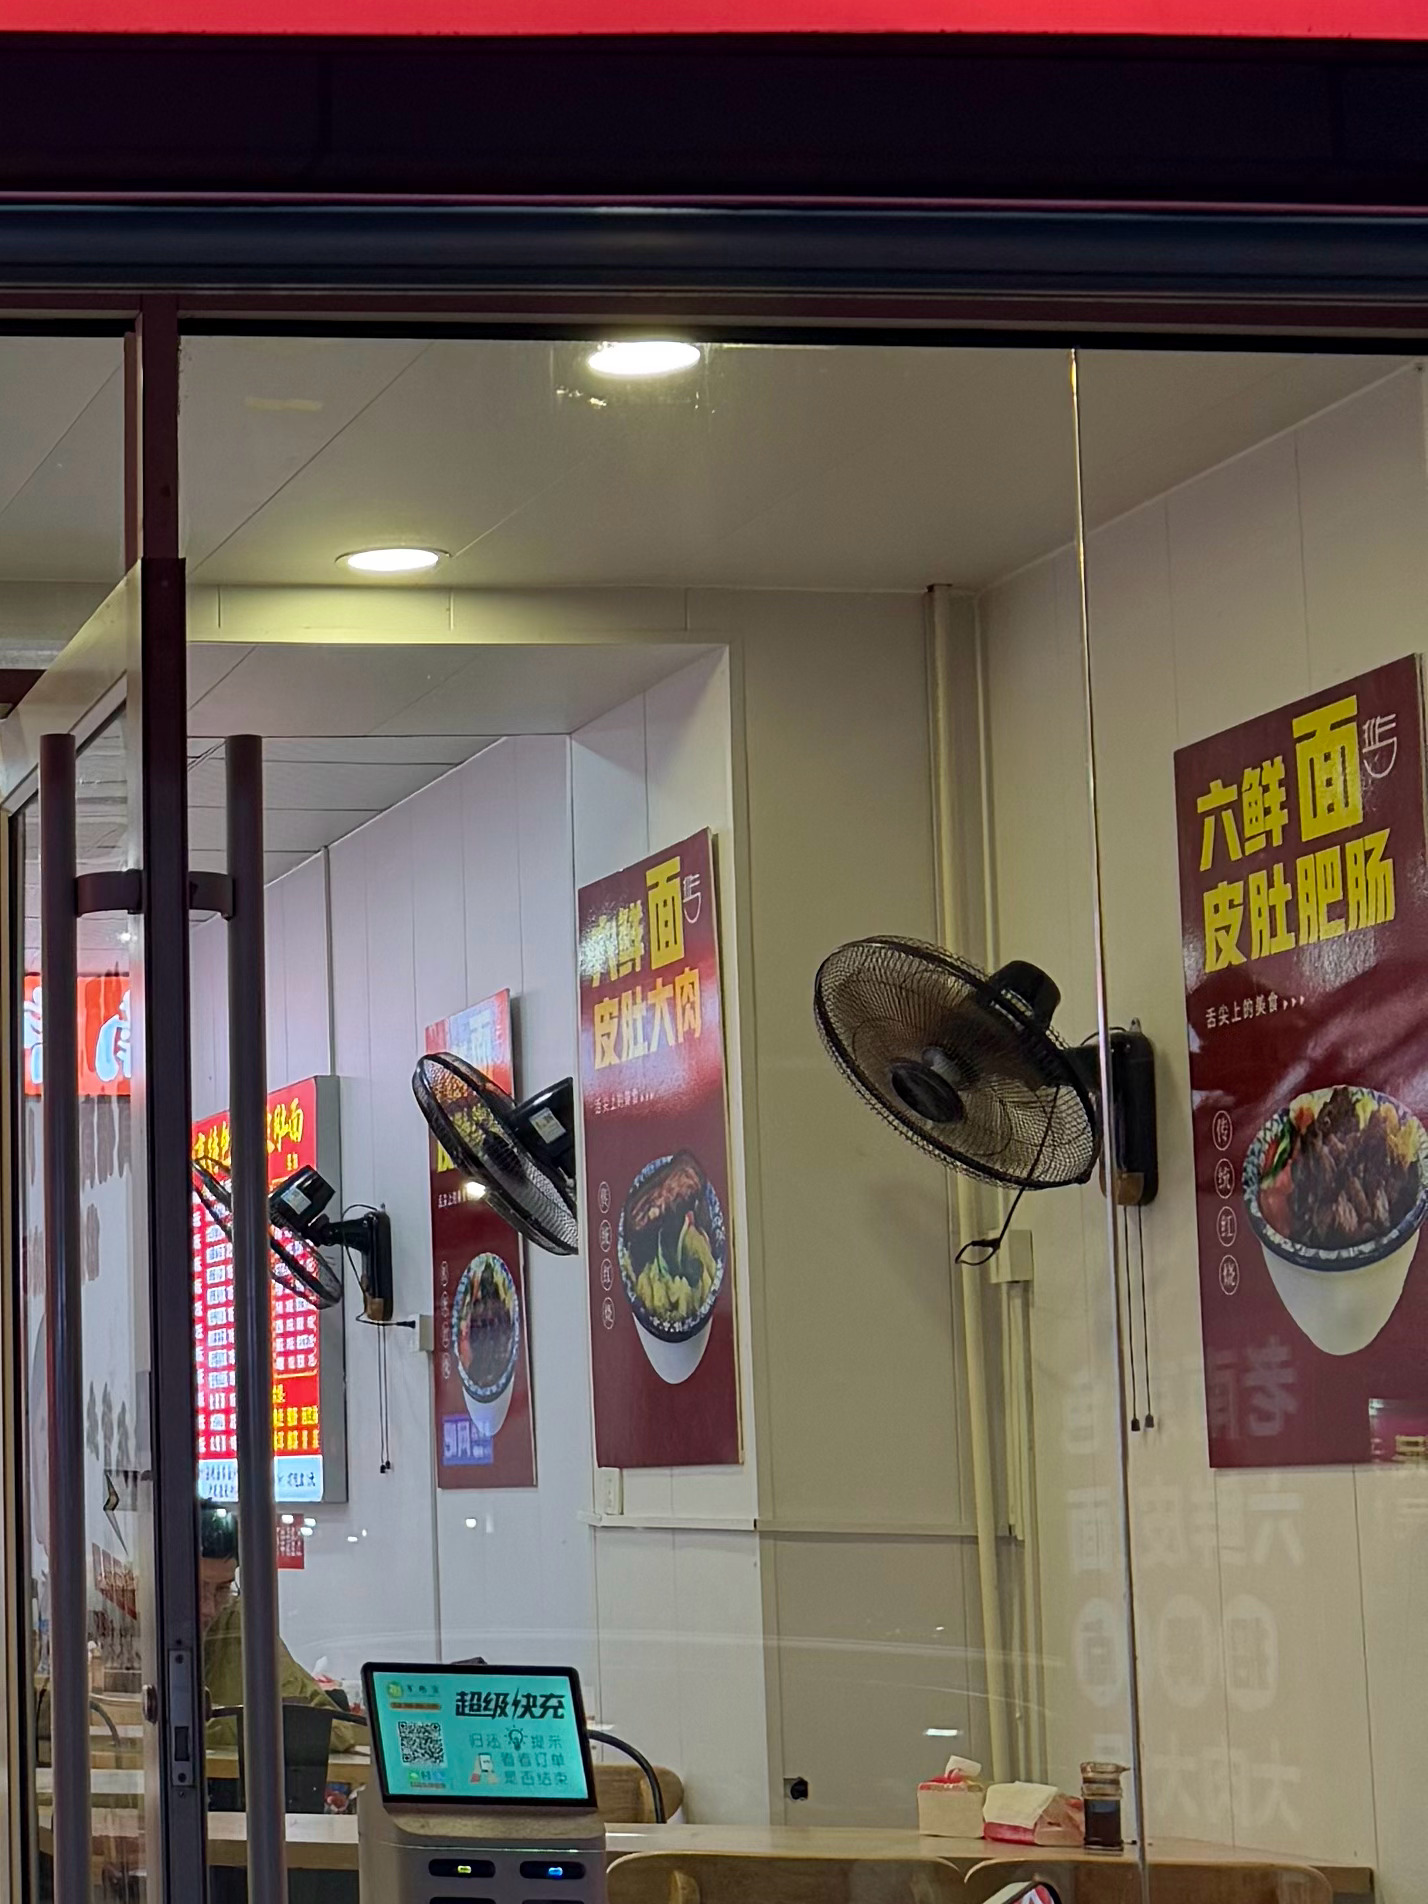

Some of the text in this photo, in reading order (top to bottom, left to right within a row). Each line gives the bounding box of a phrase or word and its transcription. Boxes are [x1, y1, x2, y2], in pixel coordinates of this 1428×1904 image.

[1197, 694, 1364, 872] 六鲜面
[1203, 828, 1395, 974] 皮肚肥肠
[594, 965, 702, 1071] 皮肚大肉
[1204, 993, 1280, 1030] 舌尖上的美食
[455, 1690, 566, 1721] 超级快充
